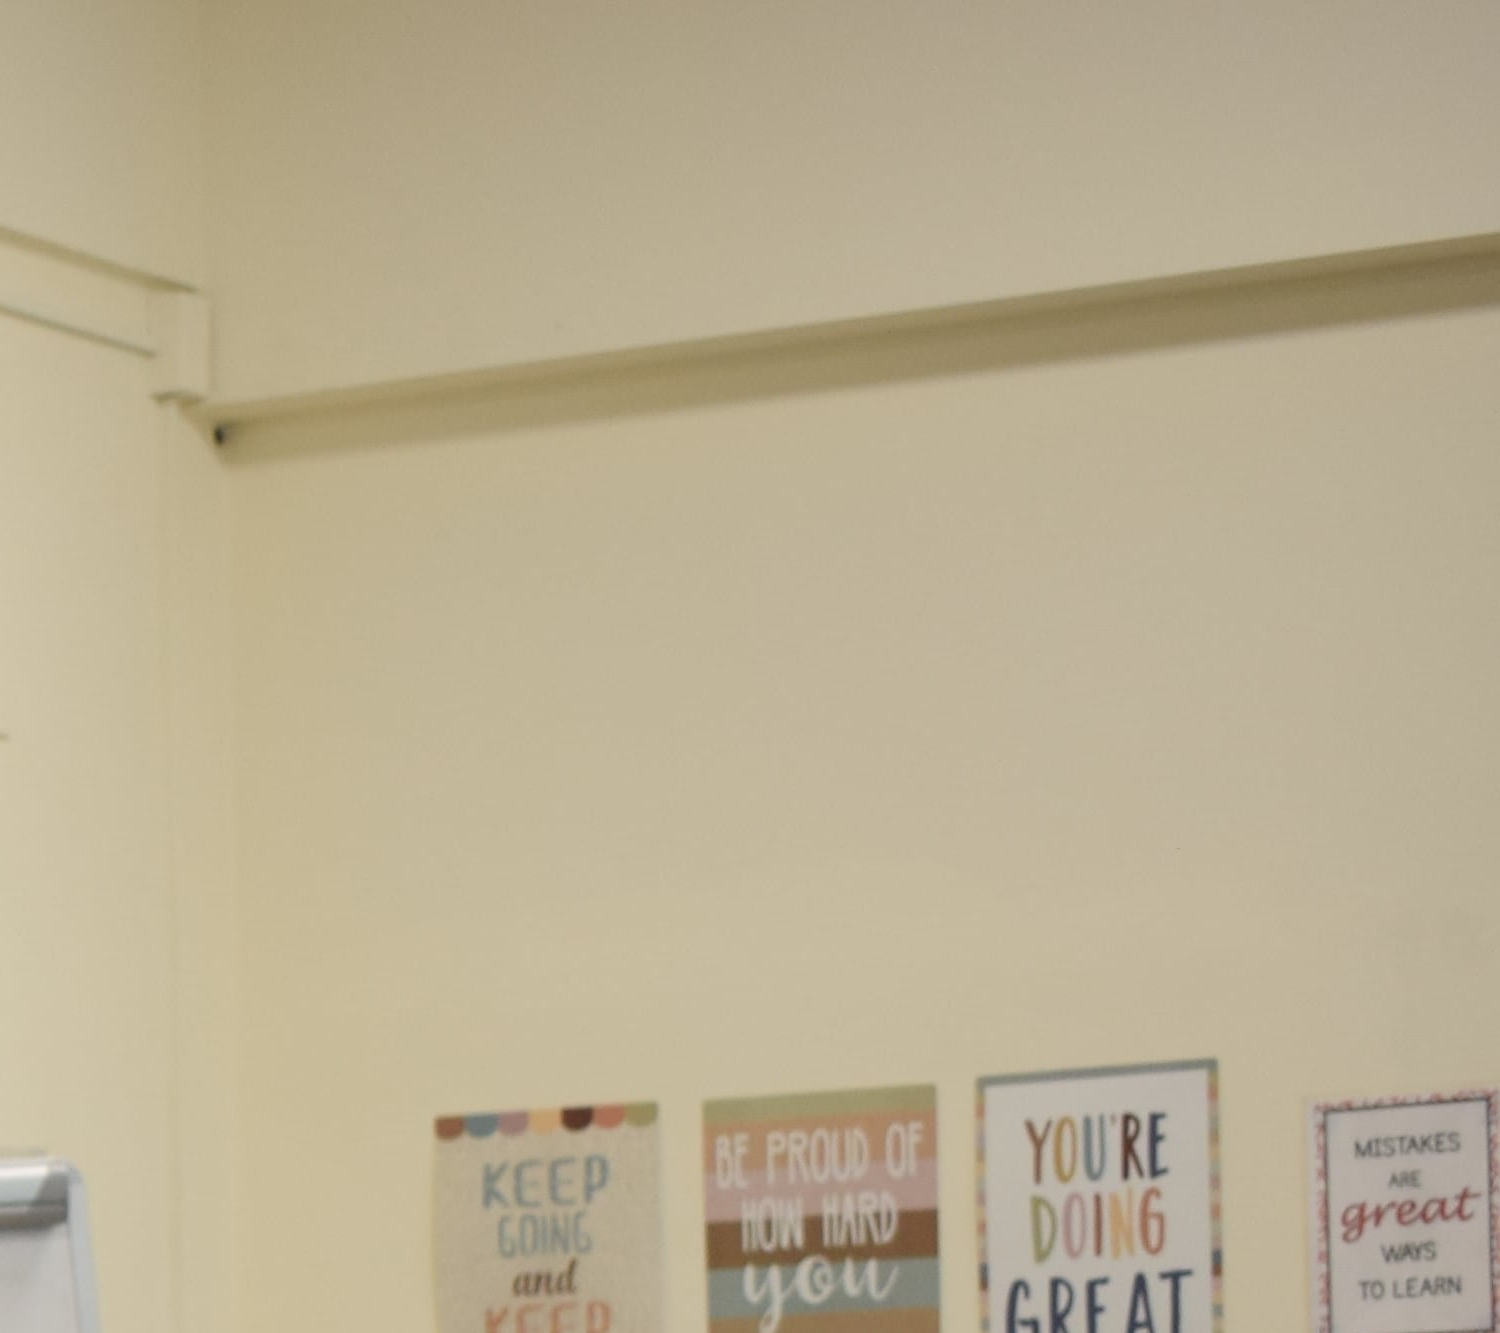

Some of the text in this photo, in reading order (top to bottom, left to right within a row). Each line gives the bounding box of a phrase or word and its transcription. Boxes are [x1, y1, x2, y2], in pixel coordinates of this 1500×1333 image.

[715, 1122, 924, 1191] BE PROUD OF
[1024, 1112, 1169, 1185] YOU'RE
[1353, 1131, 1462, 1160] MISTAKES
[482, 1154, 610, 1210] KEEP
[1388, 1169, 1422, 1189] ARE
[497, 1208, 593, 1260] GOING
[740, 1190, 899, 1254] HOW HARD
[1030, 1186, 1166, 1264] DOING
[1341, 1185, 1483, 1244] great
[512, 1257, 579, 1298] and
[1380, 1241, 1439, 1264] WAYS
[1357, 1276, 1463, 1301] TO LEARN
